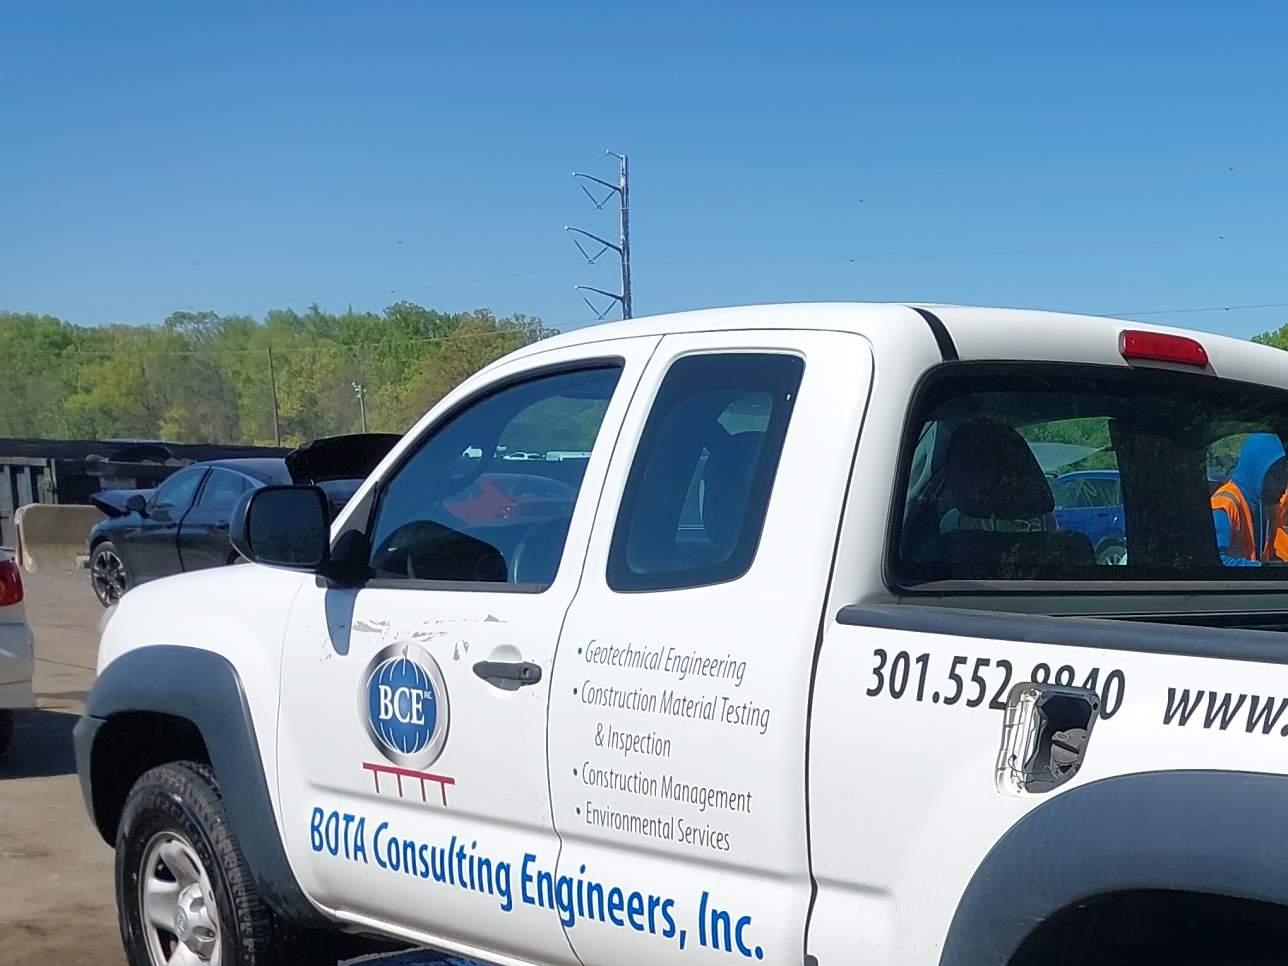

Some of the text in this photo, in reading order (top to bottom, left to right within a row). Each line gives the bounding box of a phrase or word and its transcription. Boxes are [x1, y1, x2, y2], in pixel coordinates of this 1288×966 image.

[585, 639, 747, 687] Geotechnical Engineering
[866, 648, 1126, 720] 301.5520
[378, 685, 425, 725] BCE
[581, 680, 771, 735] Construction Material Testing
[594, 722, 671, 758] & Inspection
[582, 761, 753, 814] Construction Management
[586, 801, 731, 851] Environmental Services
[310, 806, 764, 960] BOTA Consulting Engineers, Inc.
